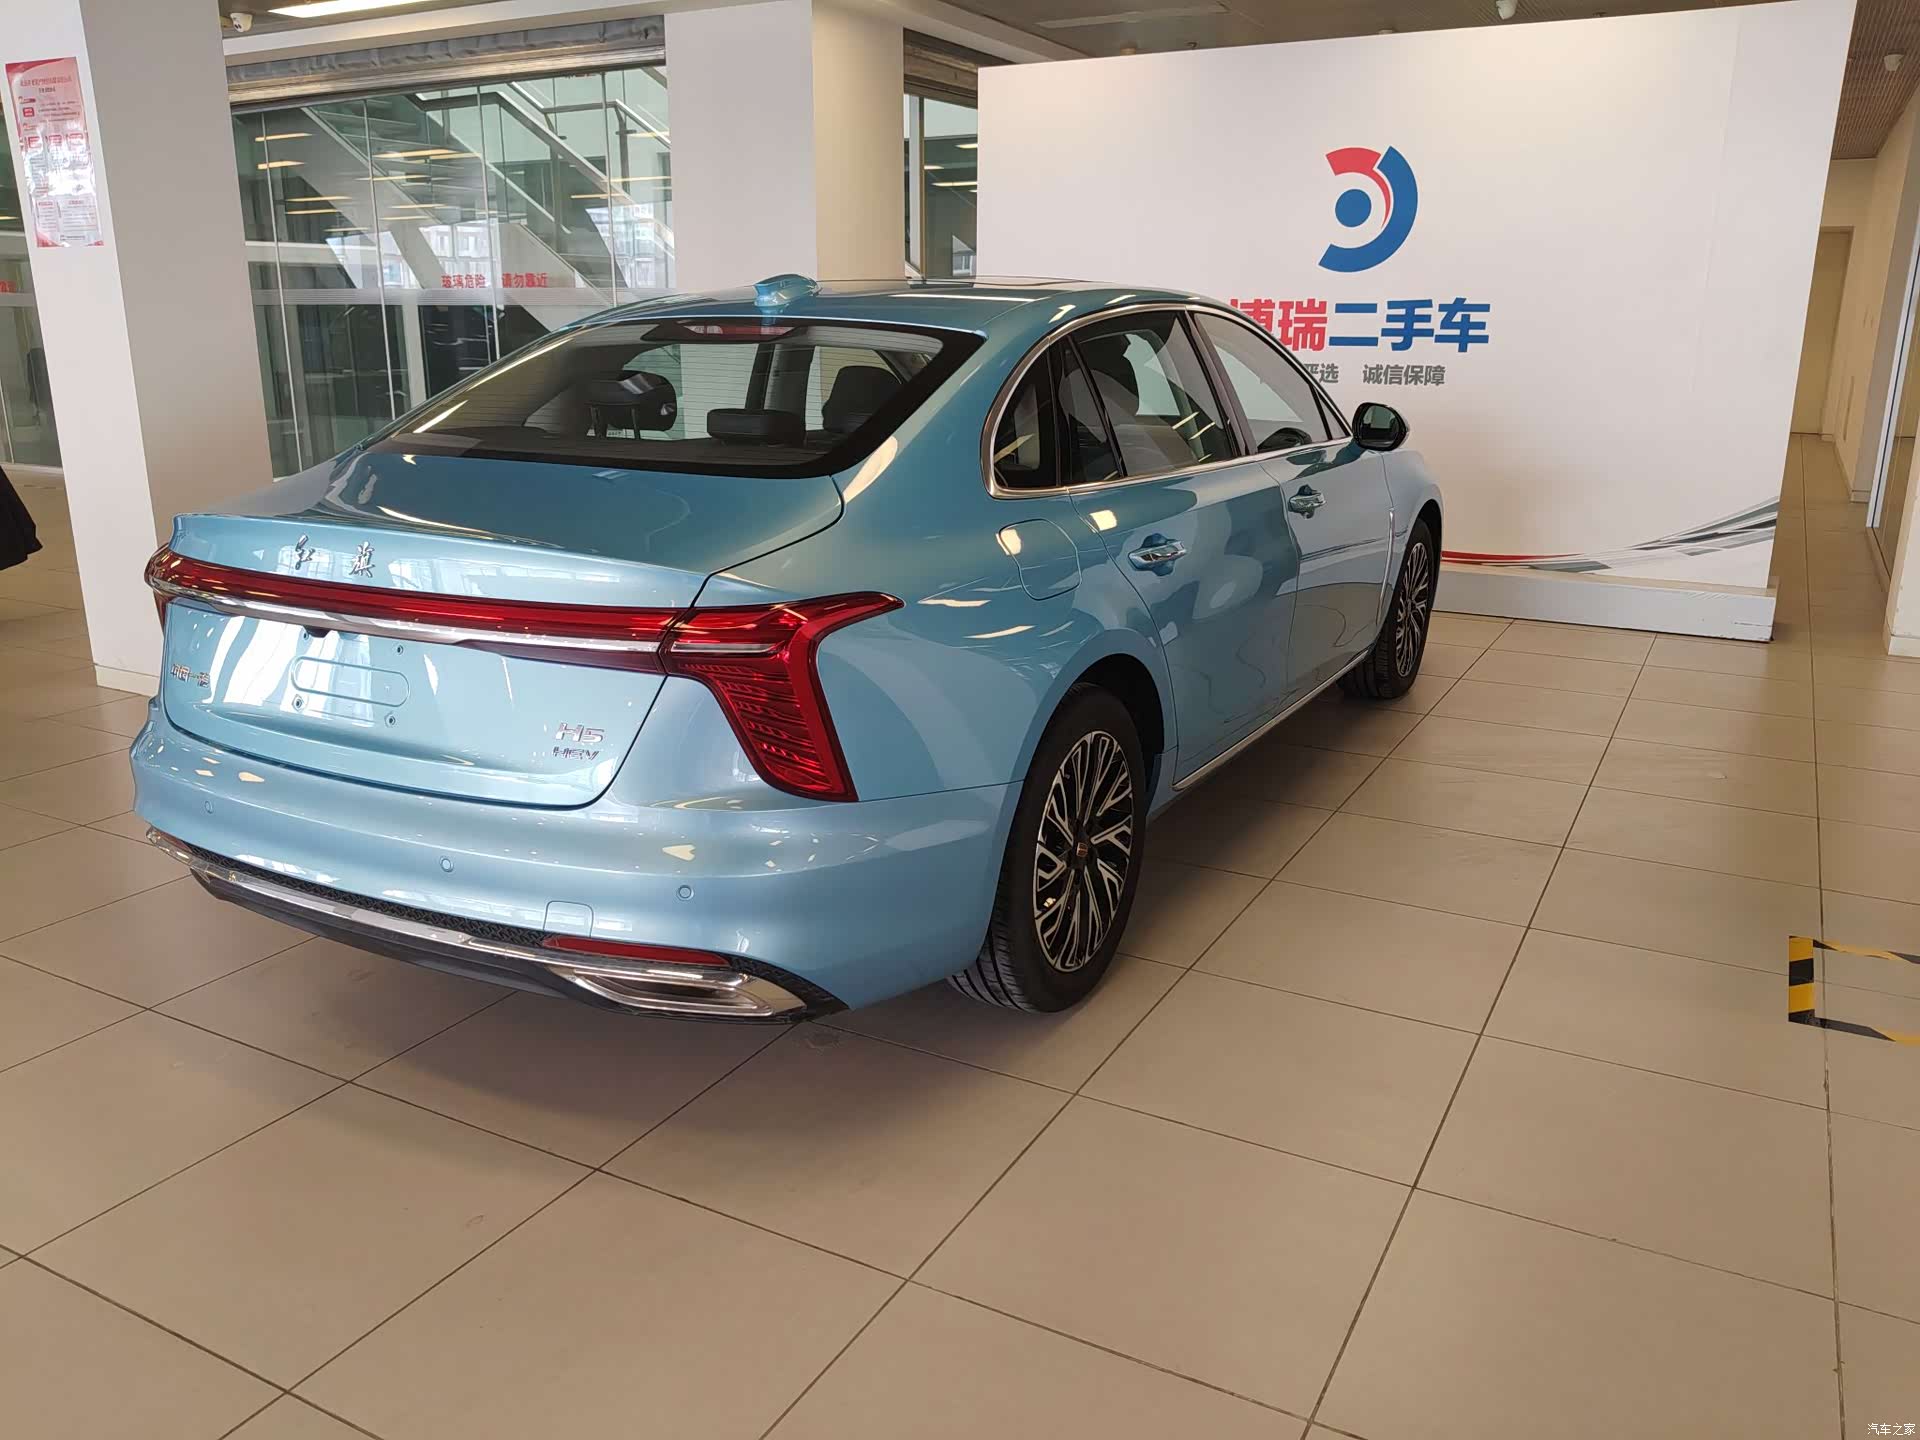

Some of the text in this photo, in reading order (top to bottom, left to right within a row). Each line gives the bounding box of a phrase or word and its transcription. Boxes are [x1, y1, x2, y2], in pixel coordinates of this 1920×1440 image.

[441, 274, 487, 289] 玻璃危险
[1362, 364, 1446, 386] 诚信保障
[294, 533, 376, 578] 红旗
[555, 722, 605, 744] H5
[553, 746, 600, 760] HEV
